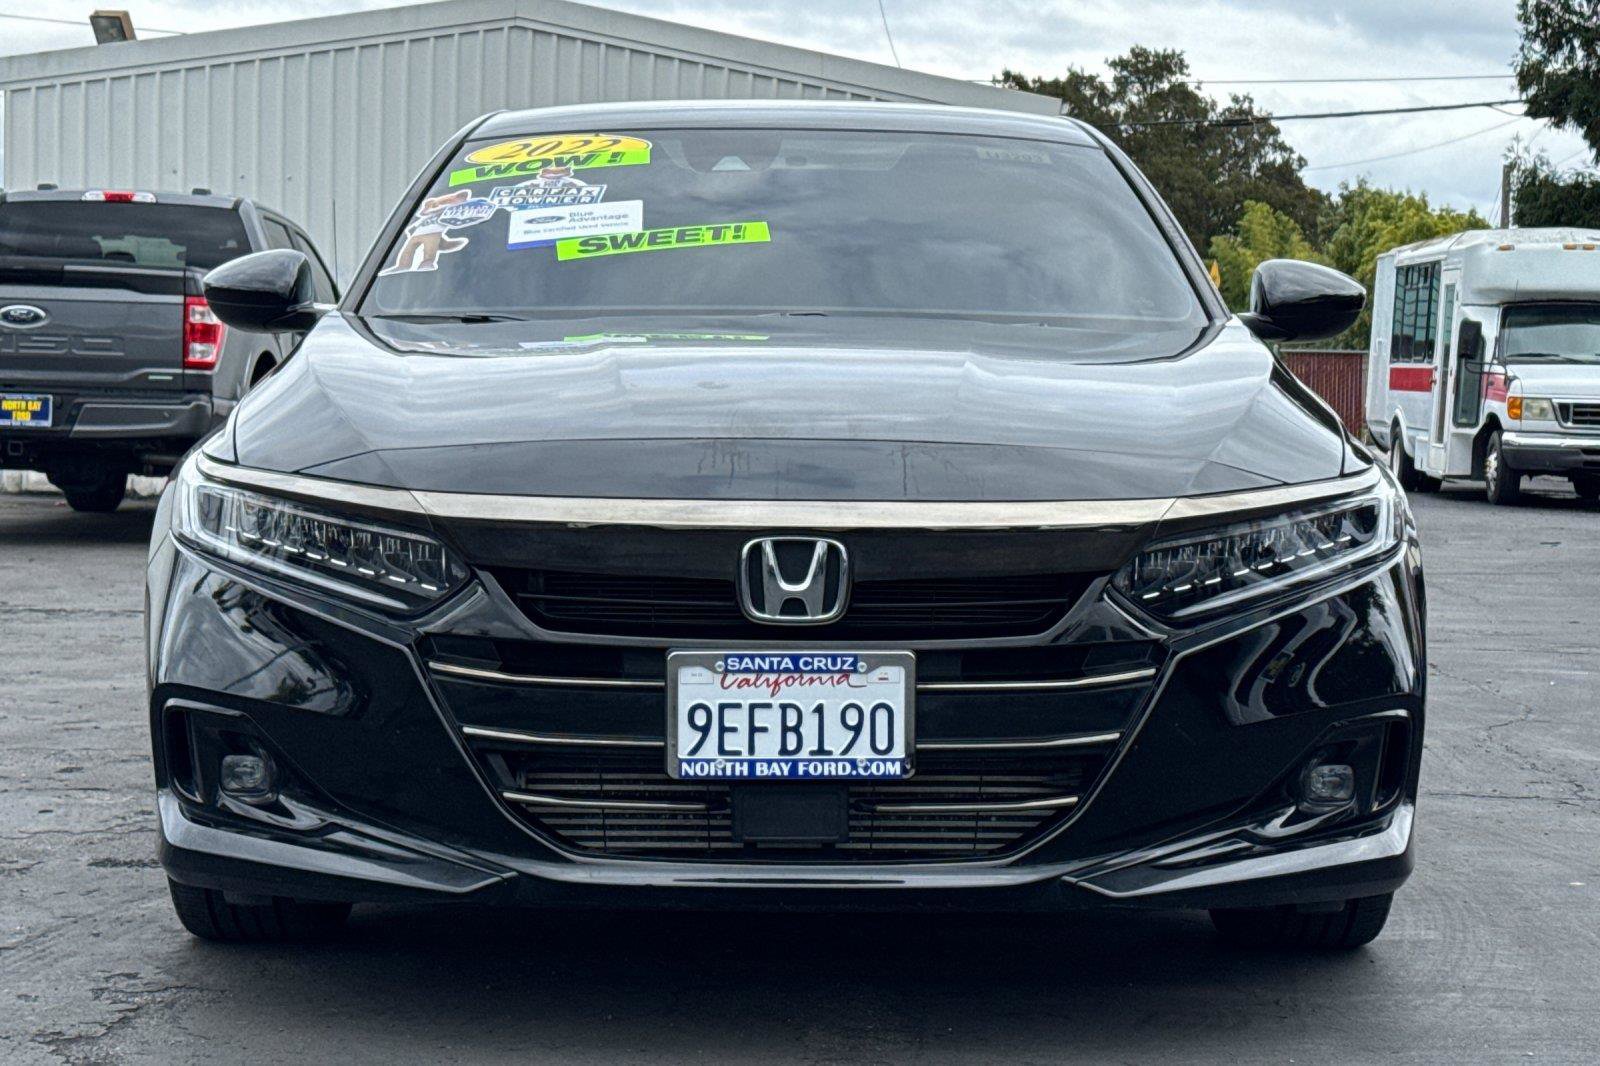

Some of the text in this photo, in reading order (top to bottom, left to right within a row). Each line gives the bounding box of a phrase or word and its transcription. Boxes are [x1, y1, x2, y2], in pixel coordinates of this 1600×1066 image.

[494, 138, 622, 161] 2022
[499, 186, 598, 197] CARFAX
[568, 213, 629, 223] Advantage
[577, 224, 746, 254] SWEET!
[727, 656, 855, 670] SANTA CRUZ
[720, 671, 867, 698] California
[687, 702, 895, 756] 9EFB190
[681, 761, 901, 776] NORTH BAY FORD.COM
